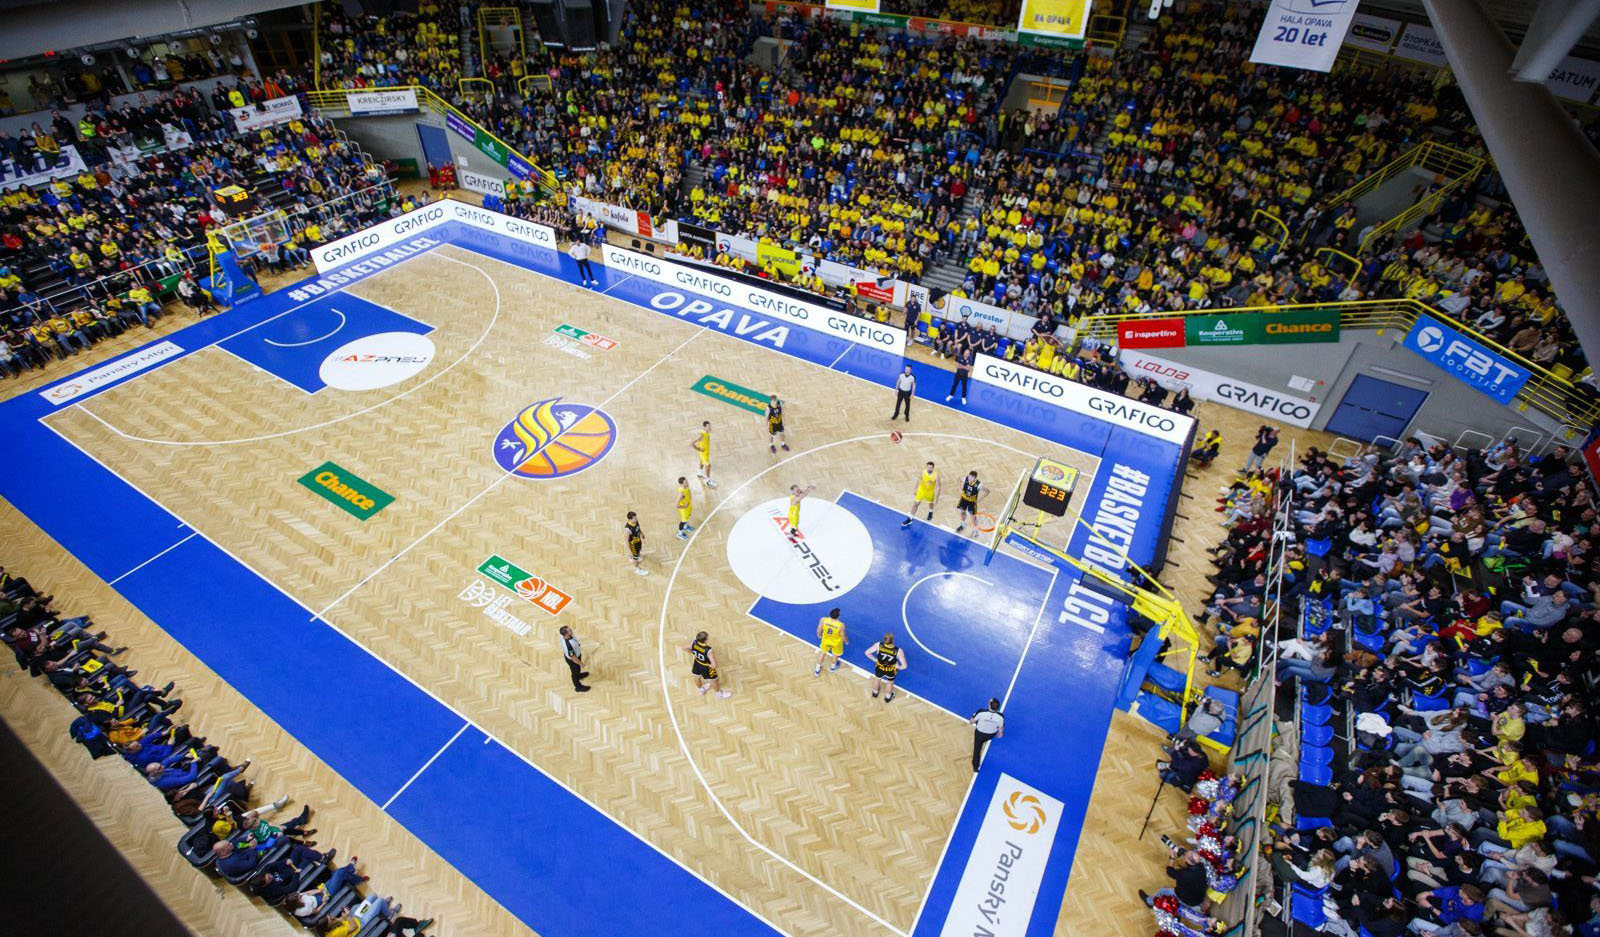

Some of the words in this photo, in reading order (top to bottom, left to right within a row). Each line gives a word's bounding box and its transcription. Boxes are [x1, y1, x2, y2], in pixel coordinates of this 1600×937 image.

[1273, 26, 1299, 43] 20
[1301, 28, 1328, 47] let
[1280, 14, 1303, 26] HALA
[1304, 17, 1333, 29] OPAVA
[464, 173, 504, 194] GRAFICO
[394, 207, 444, 234] GRAFICO
[454, 205, 495, 227] GRAFICO
[505, 220, 550, 243] GRAFICO
[323, 233, 380, 263] GRAFICO
[287, 236, 441, 302] #BASKETBALLCL
[610, 252, 661, 276] GRAFICO
[676, 271, 732, 297] GRAFICO
[650, 291, 790, 349] OPAVA
[748, 292, 809, 320] GRAFICO
[973, 310, 1004, 326] prestar
[827, 316, 895, 346] GRAFICO
[1265, 322, 1333, 335] Chance
[1440, 355, 1507, 397] LOGISTICS
[1445, 340, 1520, 385] FBT
[703, 380, 768, 411] Chance
[985, 364, 1065, 399] GRAFICO
[1088, 396, 1176, 432] GRAFICO
[1216, 383, 1311, 420] GRAFICO
[314, 470, 376, 512] Chance
[1058, 463, 1151, 635] #BASKETBLCL
[879, 652, 895, 663] 77
[977, 839, 1023, 926] Panský
